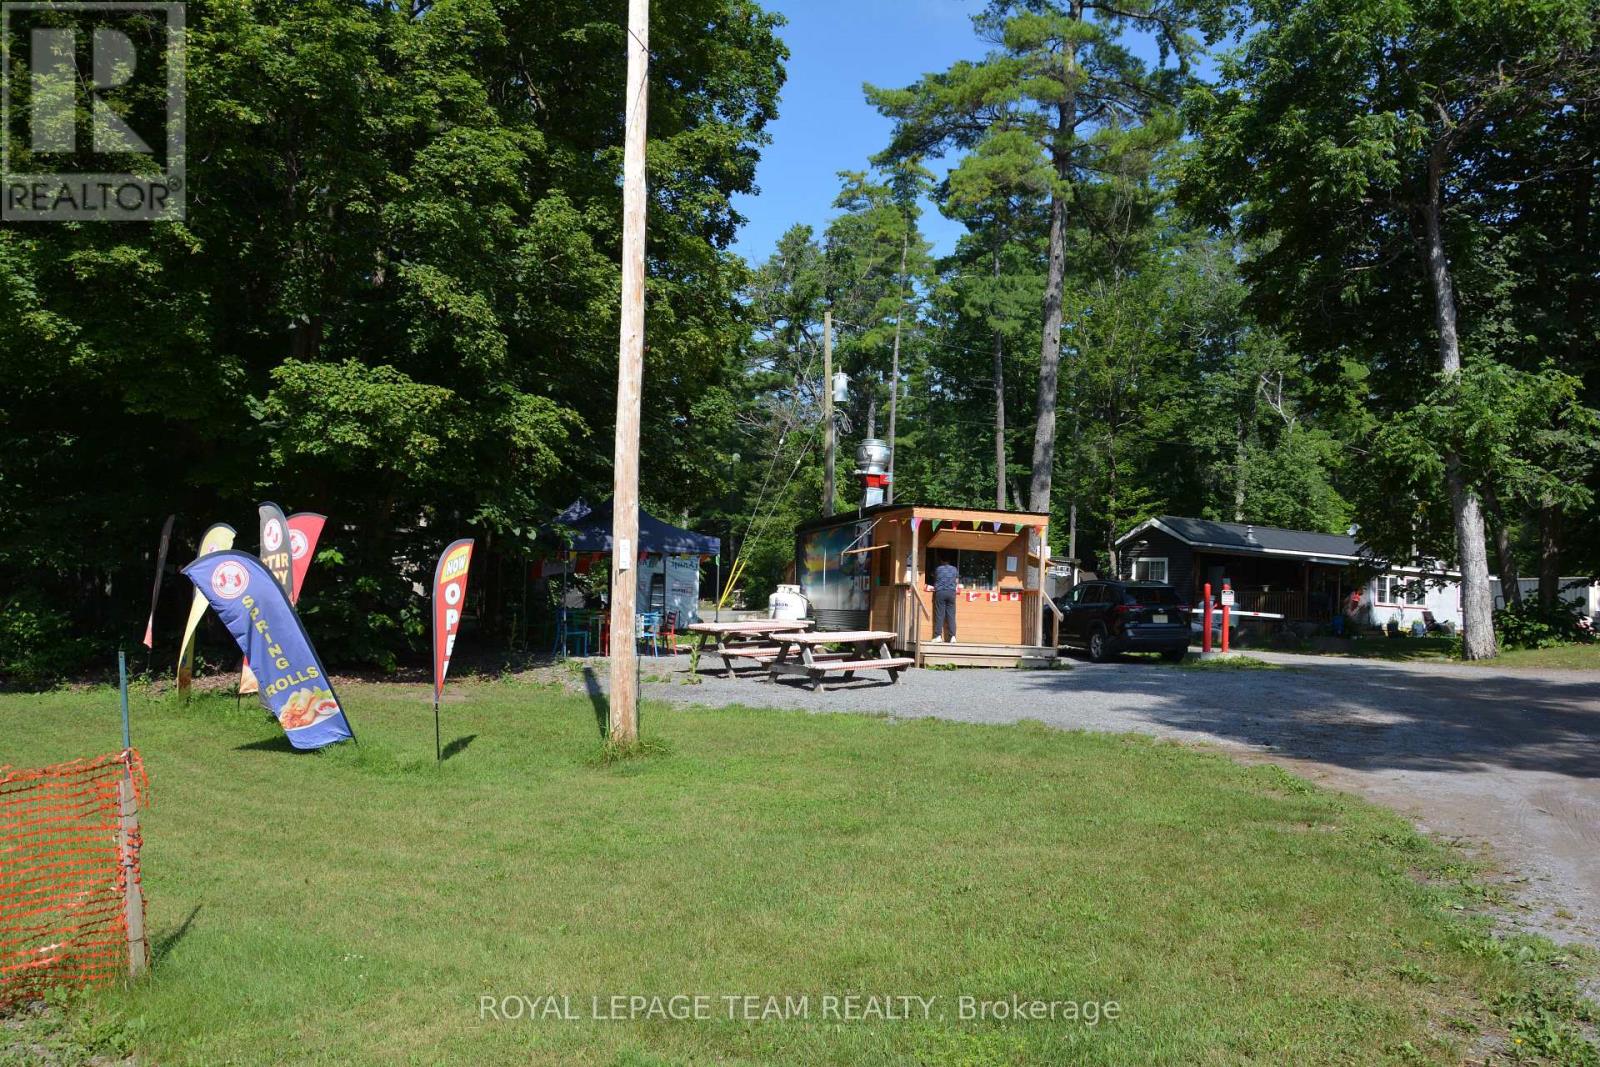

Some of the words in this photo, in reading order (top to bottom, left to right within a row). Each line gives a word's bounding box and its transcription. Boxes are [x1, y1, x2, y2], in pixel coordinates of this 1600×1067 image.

[446, 555, 465, 577] NOW
[242, 595, 290, 670] SPRING
[266, 666, 320, 697] ROLLS
